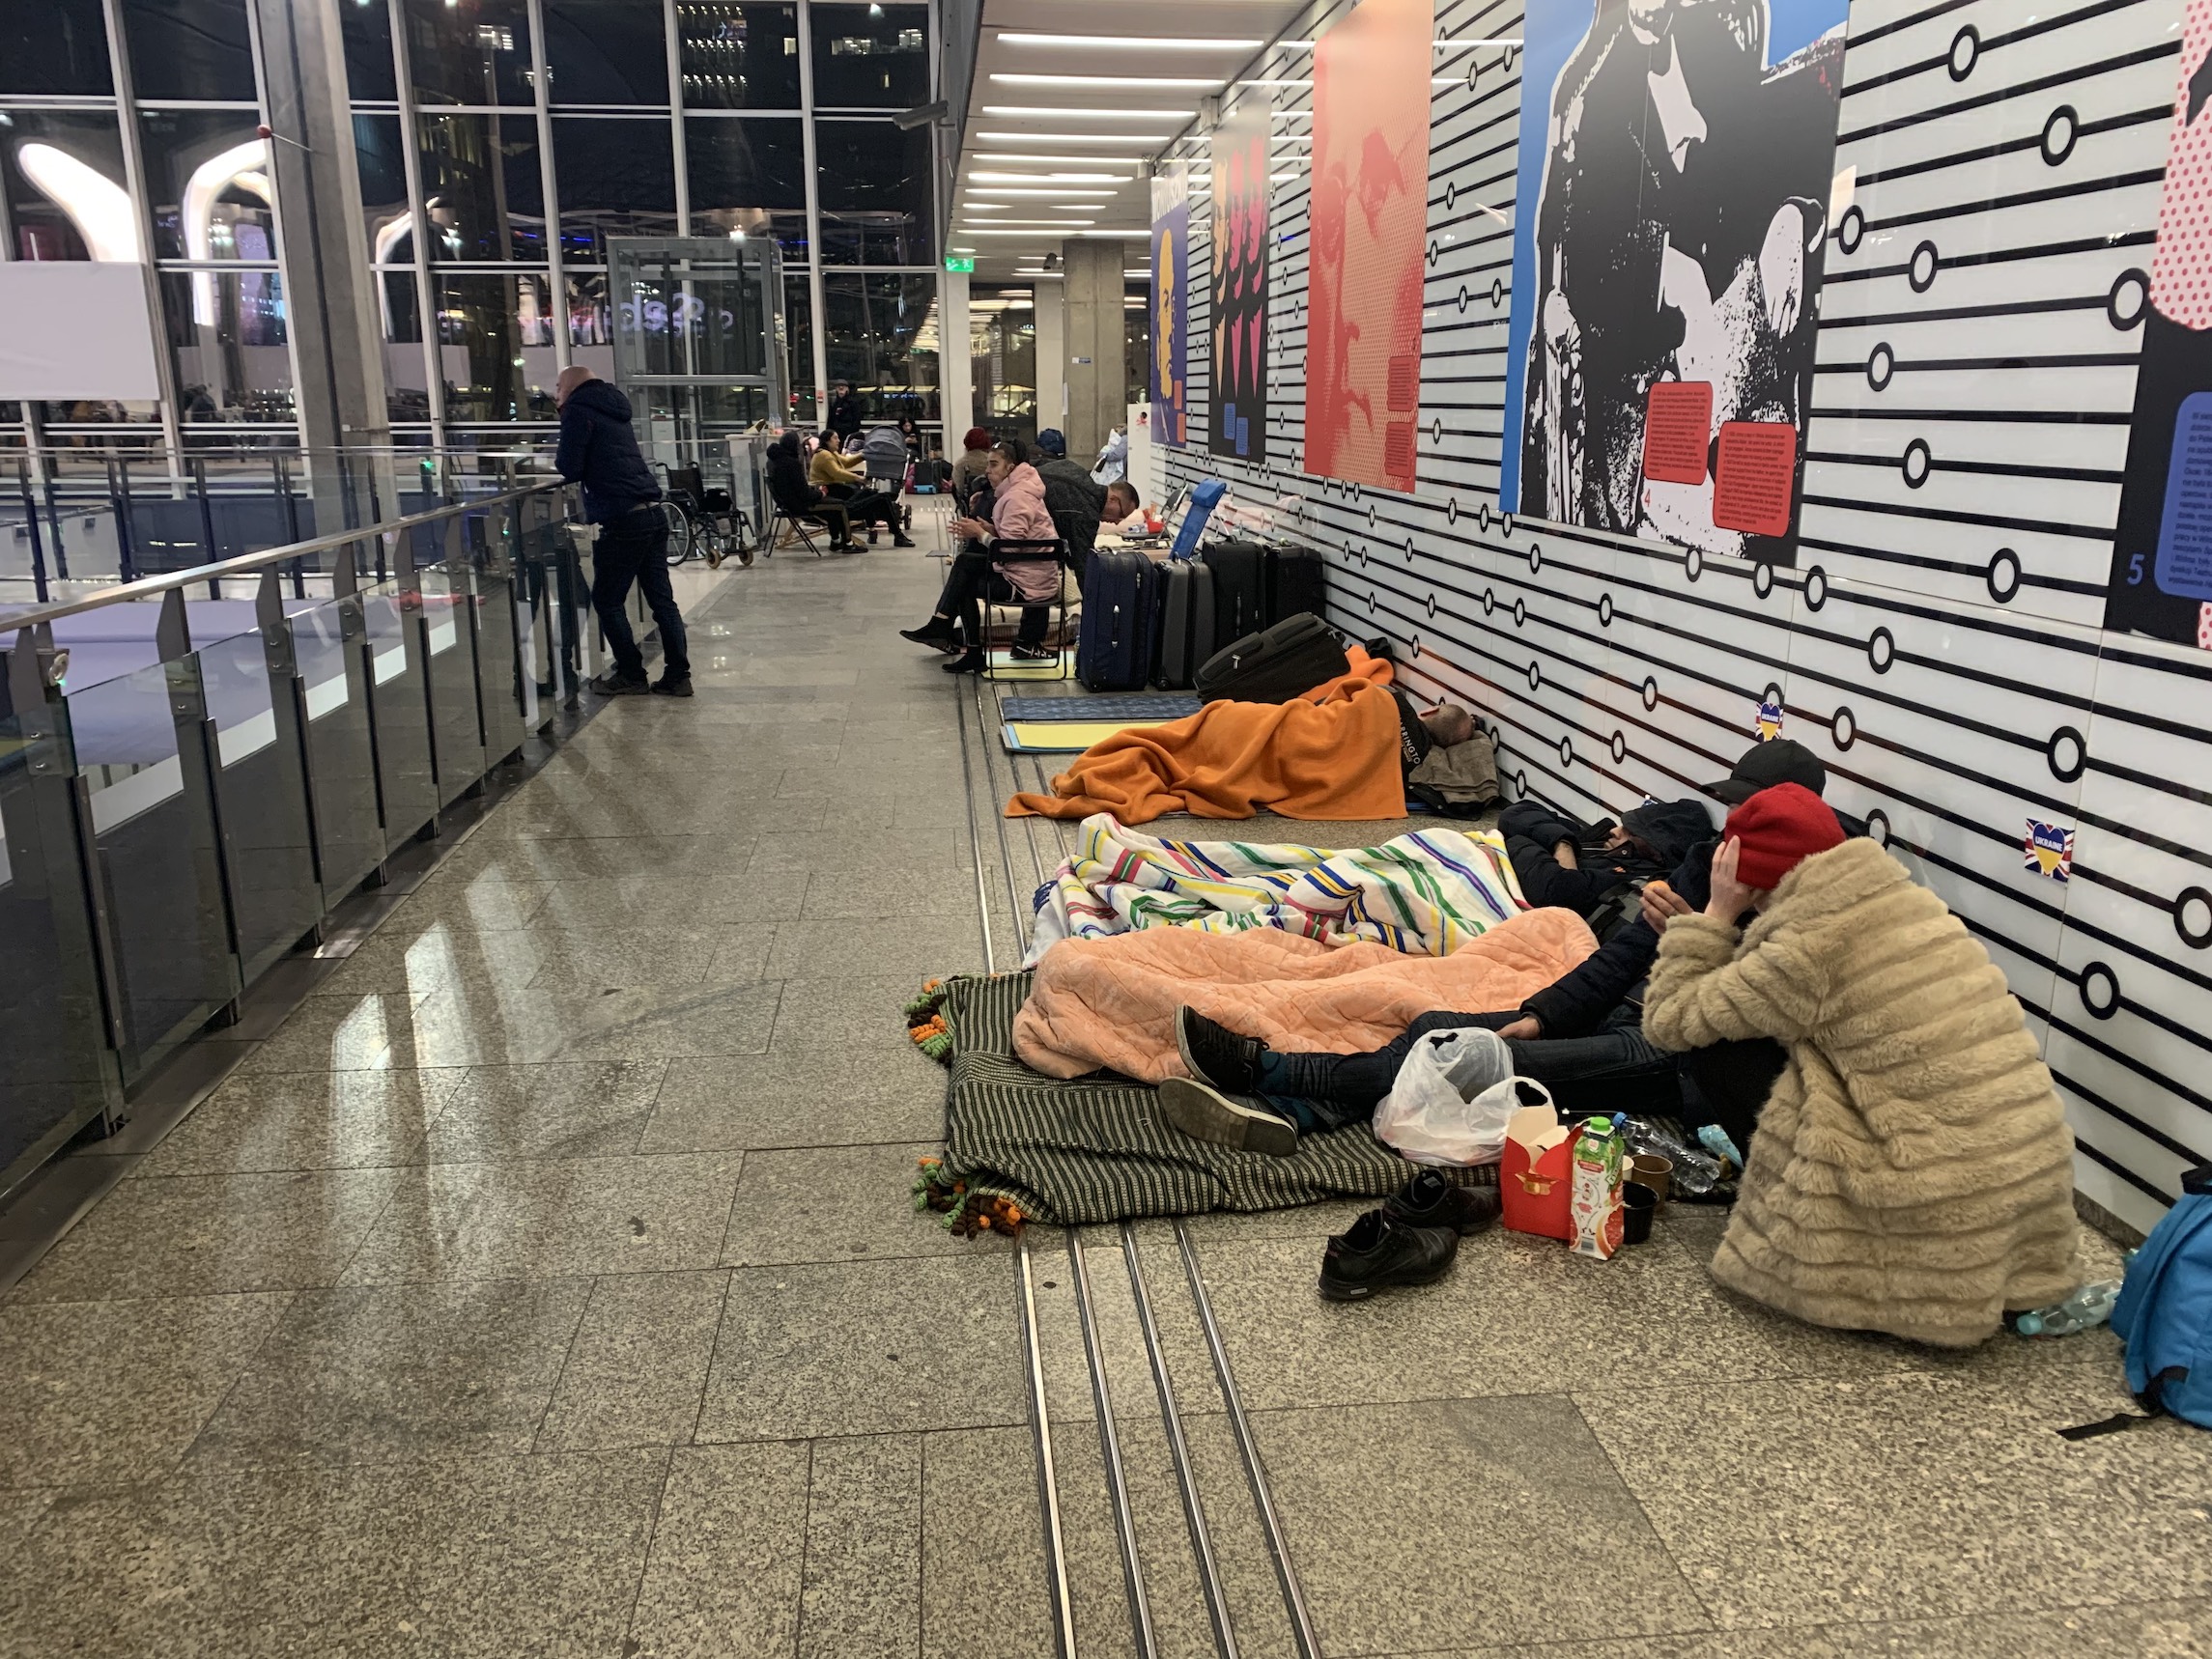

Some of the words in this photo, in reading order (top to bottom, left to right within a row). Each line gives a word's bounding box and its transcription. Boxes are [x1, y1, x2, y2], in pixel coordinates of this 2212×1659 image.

[1644, 488, 1651, 507] 4
[2127, 552, 2145, 585] 5
[2035, 836, 2063, 852] UKRAINE
